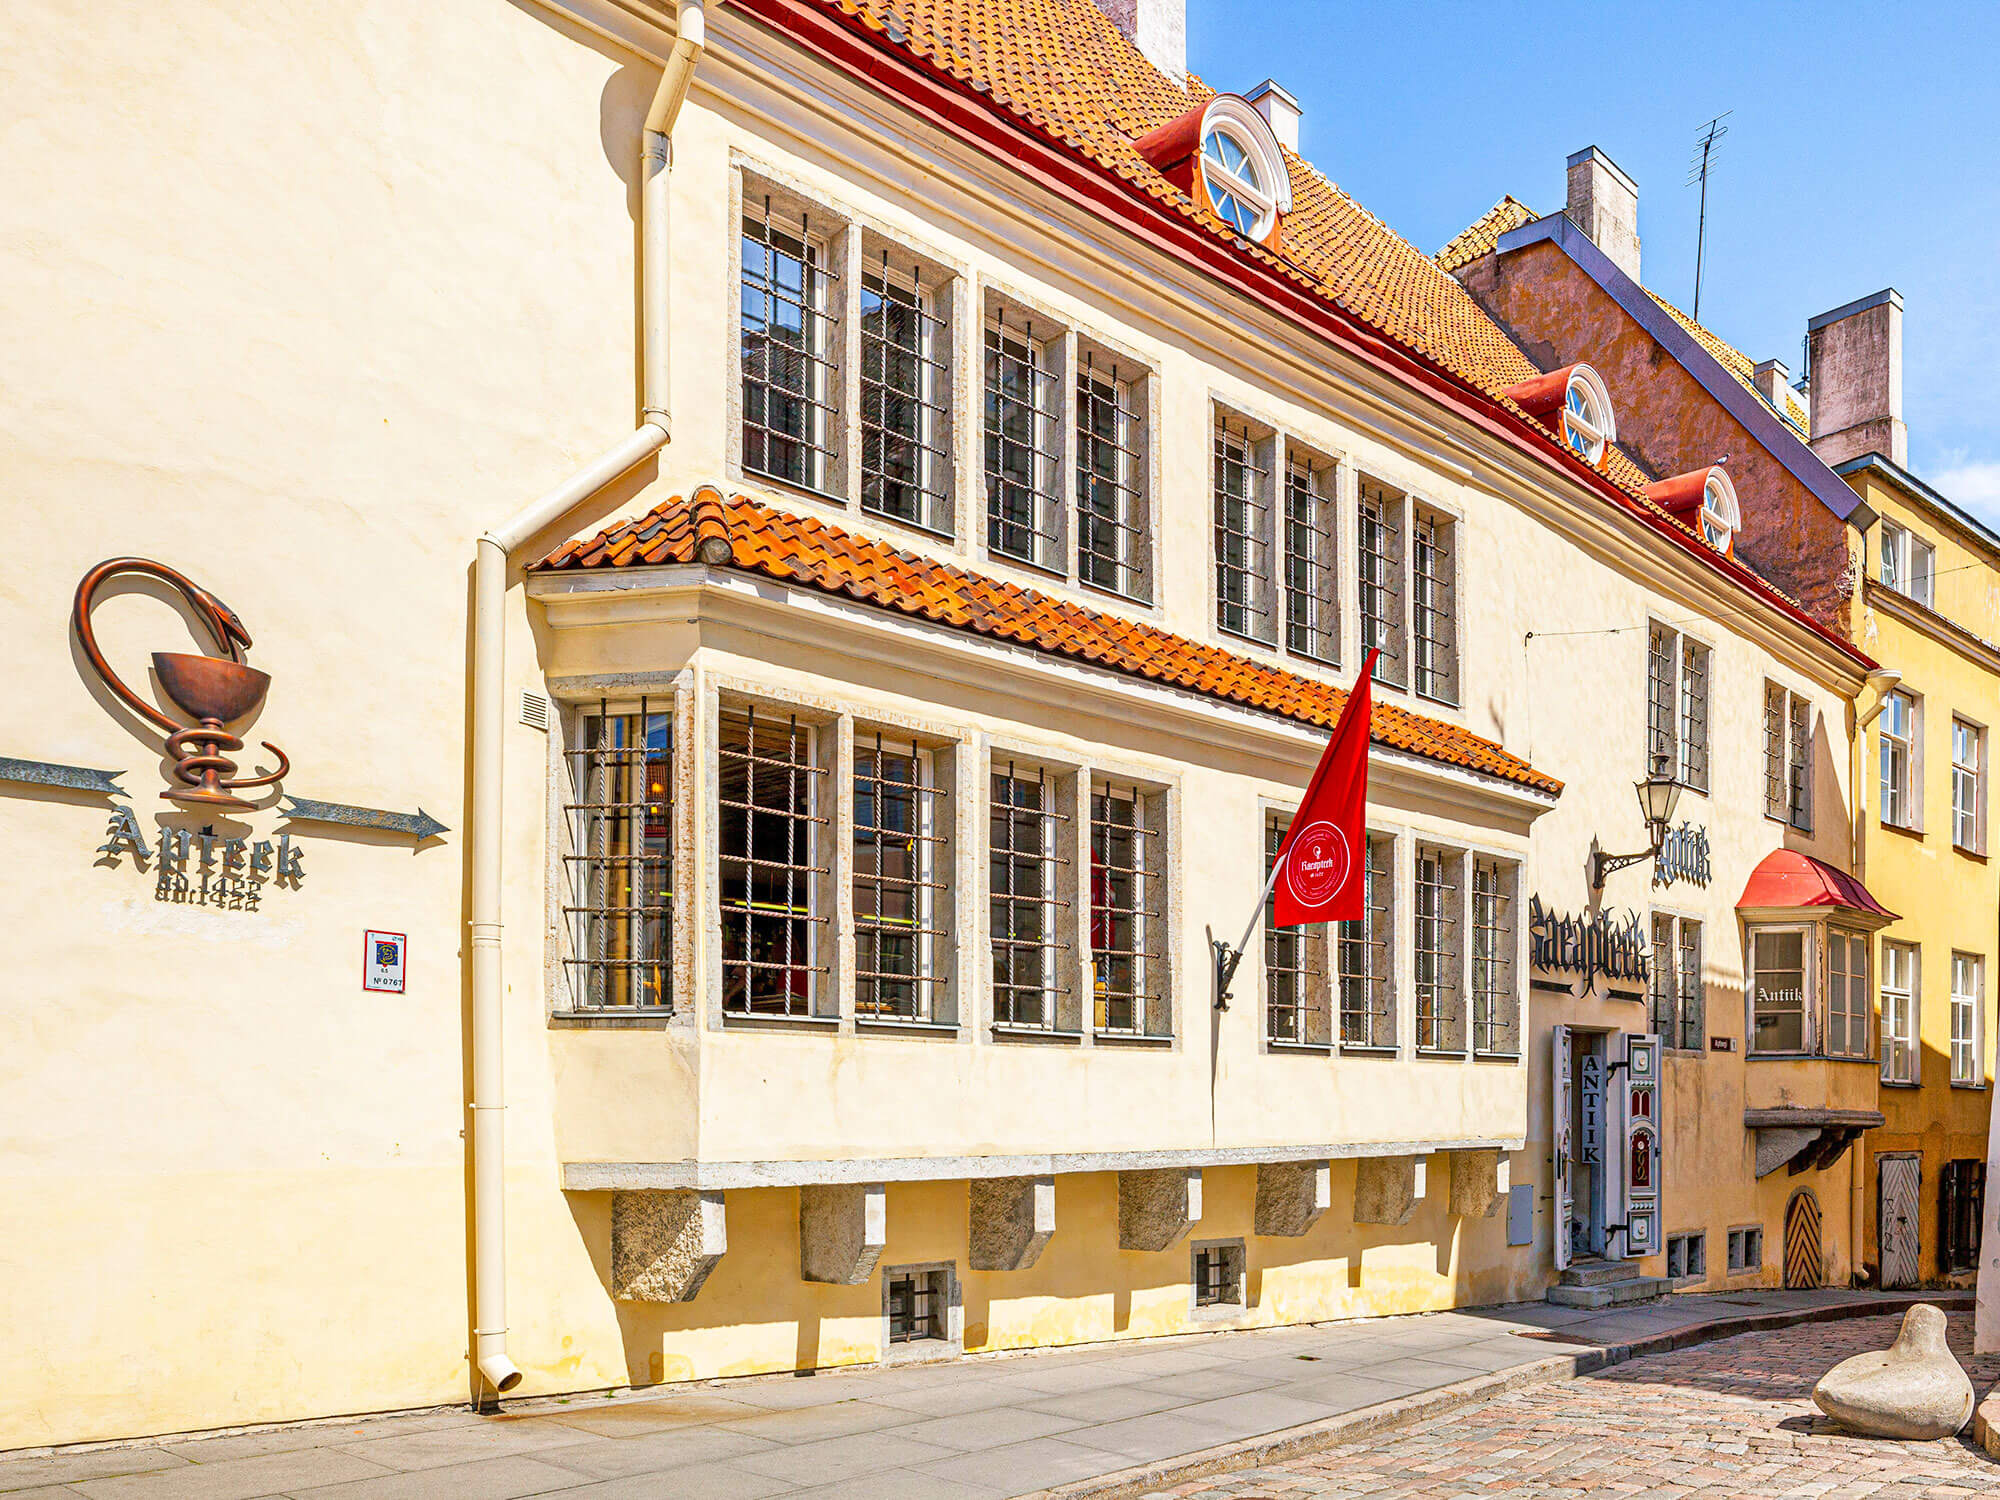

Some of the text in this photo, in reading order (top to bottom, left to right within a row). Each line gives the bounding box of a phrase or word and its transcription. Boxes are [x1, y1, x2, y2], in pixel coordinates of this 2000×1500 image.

[96, 805, 306, 878] Apteek
[382, 978, 403, 986] 0767
[1757, 987, 1803, 1001] Antiik
[1583, 1056, 1600, 1162] ANTIIK
